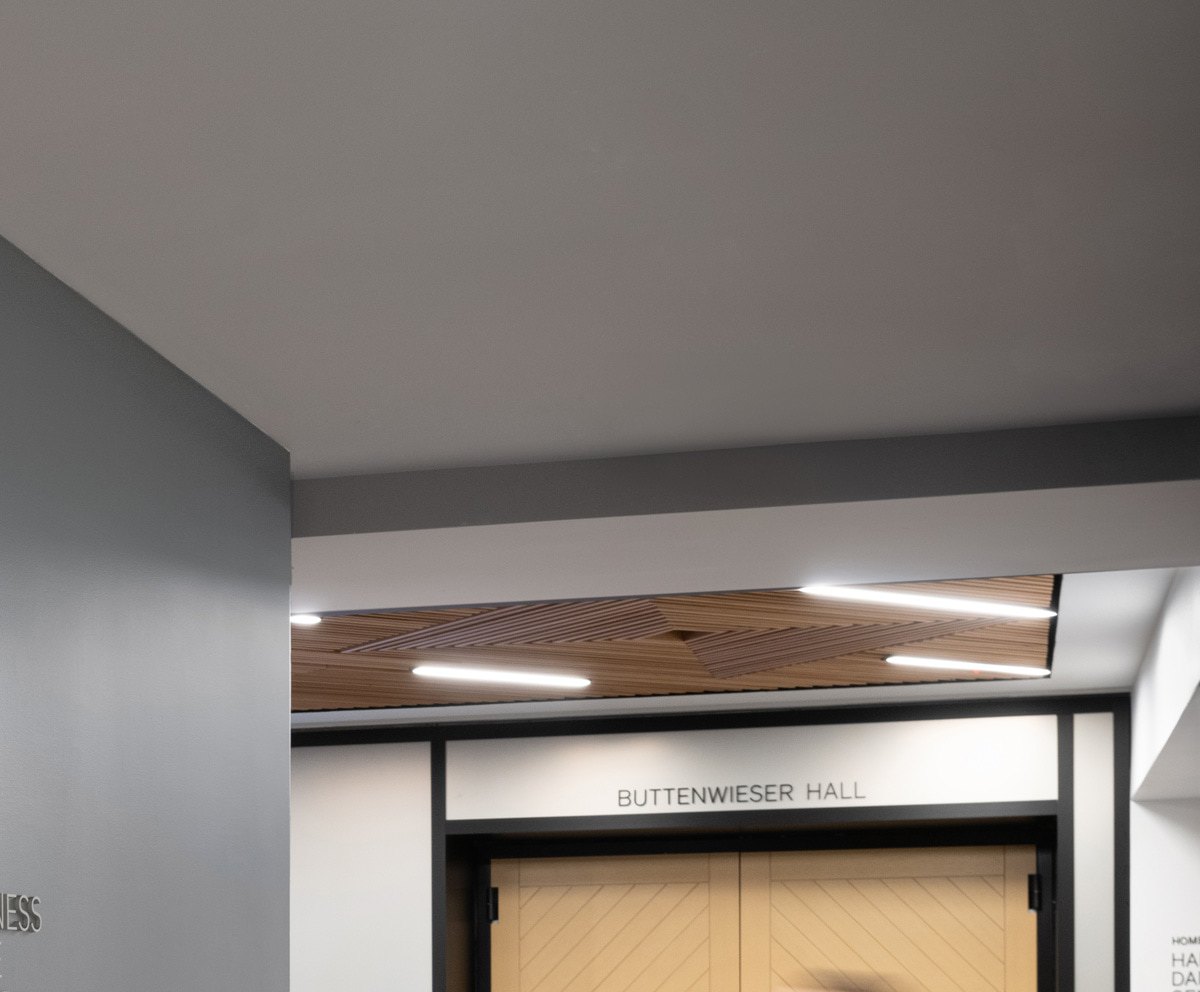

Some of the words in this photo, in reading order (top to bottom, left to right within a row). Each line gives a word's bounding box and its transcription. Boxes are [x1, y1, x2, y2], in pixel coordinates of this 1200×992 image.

[618, 783, 794, 807] BUTTENWIESER
[806, 781, 866, 801] HALL
[1172, 952, 1200, 968] HA
[1172, 971, 1200, 987] DA
